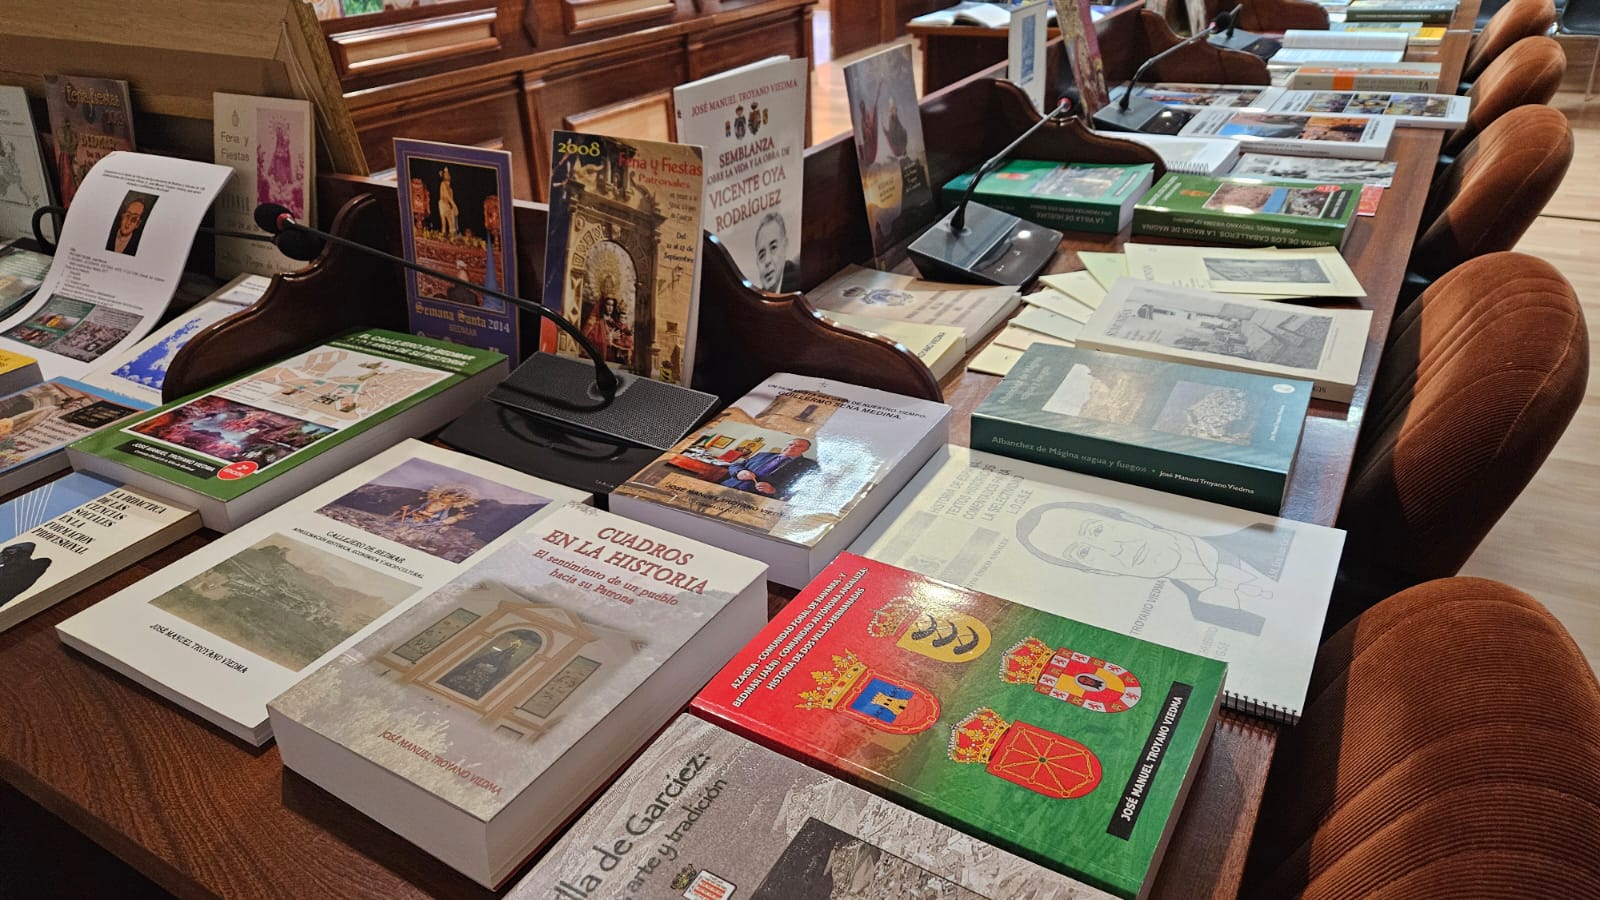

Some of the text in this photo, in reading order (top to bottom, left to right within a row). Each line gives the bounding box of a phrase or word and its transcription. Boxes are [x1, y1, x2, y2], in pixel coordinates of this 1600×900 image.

[692, 79, 798, 117] JOSÉ MANUEL TROYANO VIEDMA
[220, 131, 249, 147] Feria y
[221, 149, 250, 162] Fiestas
[558, 142, 600, 157] 2008
[719, 136, 775, 168] SEMBLANZA
[618, 152, 703, 177] Feria y Fiestas
[638, 173, 690, 189] Patronales
[725, 168, 734, 179] LA
[734, 162, 748, 175] VIDA
[749, 159, 754, 168] Y
[754, 157, 762, 167] LA
[762, 151, 779, 163] OBRA
[709, 174, 760, 209] VICENTE
[762, 165, 786, 187] OYA
[716, 189, 782, 233] RODRÍGUEZ
[415, 302, 511, 334] Semana Santa 2014
[778, 390, 832, 406] GUILLERMO
[833, 401, 860, 412] SENA
[991, 435, 1035, 451] Albanchez
[1036, 444, 1047, 452] de
[1048, 447, 1079, 460] Mágina
[1108, 459, 1114, 468] y
[1159, 470, 1255, 494] José Manuel Troyano Viedma
[72, 508, 116, 528] SOCIALES
[85, 502, 128, 520] CIENCIAS
[109, 500, 130, 512] LAS
[946, 493, 971, 515] TEXTOS
[31, 527, 89, 555] PROFESIONAL
[326, 531, 406, 564] CALLEJERO DE BEDMAR
[597, 527, 694, 566] CUADROS
[532, 549, 679, 606] El sentimiento de un pueblo
[542, 529, 709, 594] EN LA HISTORIA
[549, 568, 635, 605] hacia su Patrona
[1129, 579, 1167, 635] TROYANO VIEDMA
[149, 623, 249, 674] JOSÉ MANUEL TROYANO VIEDMA
[730, 662, 759, 690] AZAGRA
[758, 623, 796, 661] COMUNIDAD
[792, 609, 812, 628] FORAL
[808, 600, 818, 611] DE
[766, 587, 866, 691] HISTORIA DE DOS VILLAS HERMANADAS
[732, 676, 762, 708] BEDMAR
[779, 621, 815, 659] COMUNIDAD
[378, 730, 503, 796] JOSÉ MANUEL TROYANO VIEDMA
[1121, 696, 1184, 822] JOSÉ MANUEL TROYANO VIEDMA
[664, 778, 728, 842] tradición
[592, 839, 633, 872] de
[658, 843, 678, 862] y
[627, 856, 662, 894] arte
